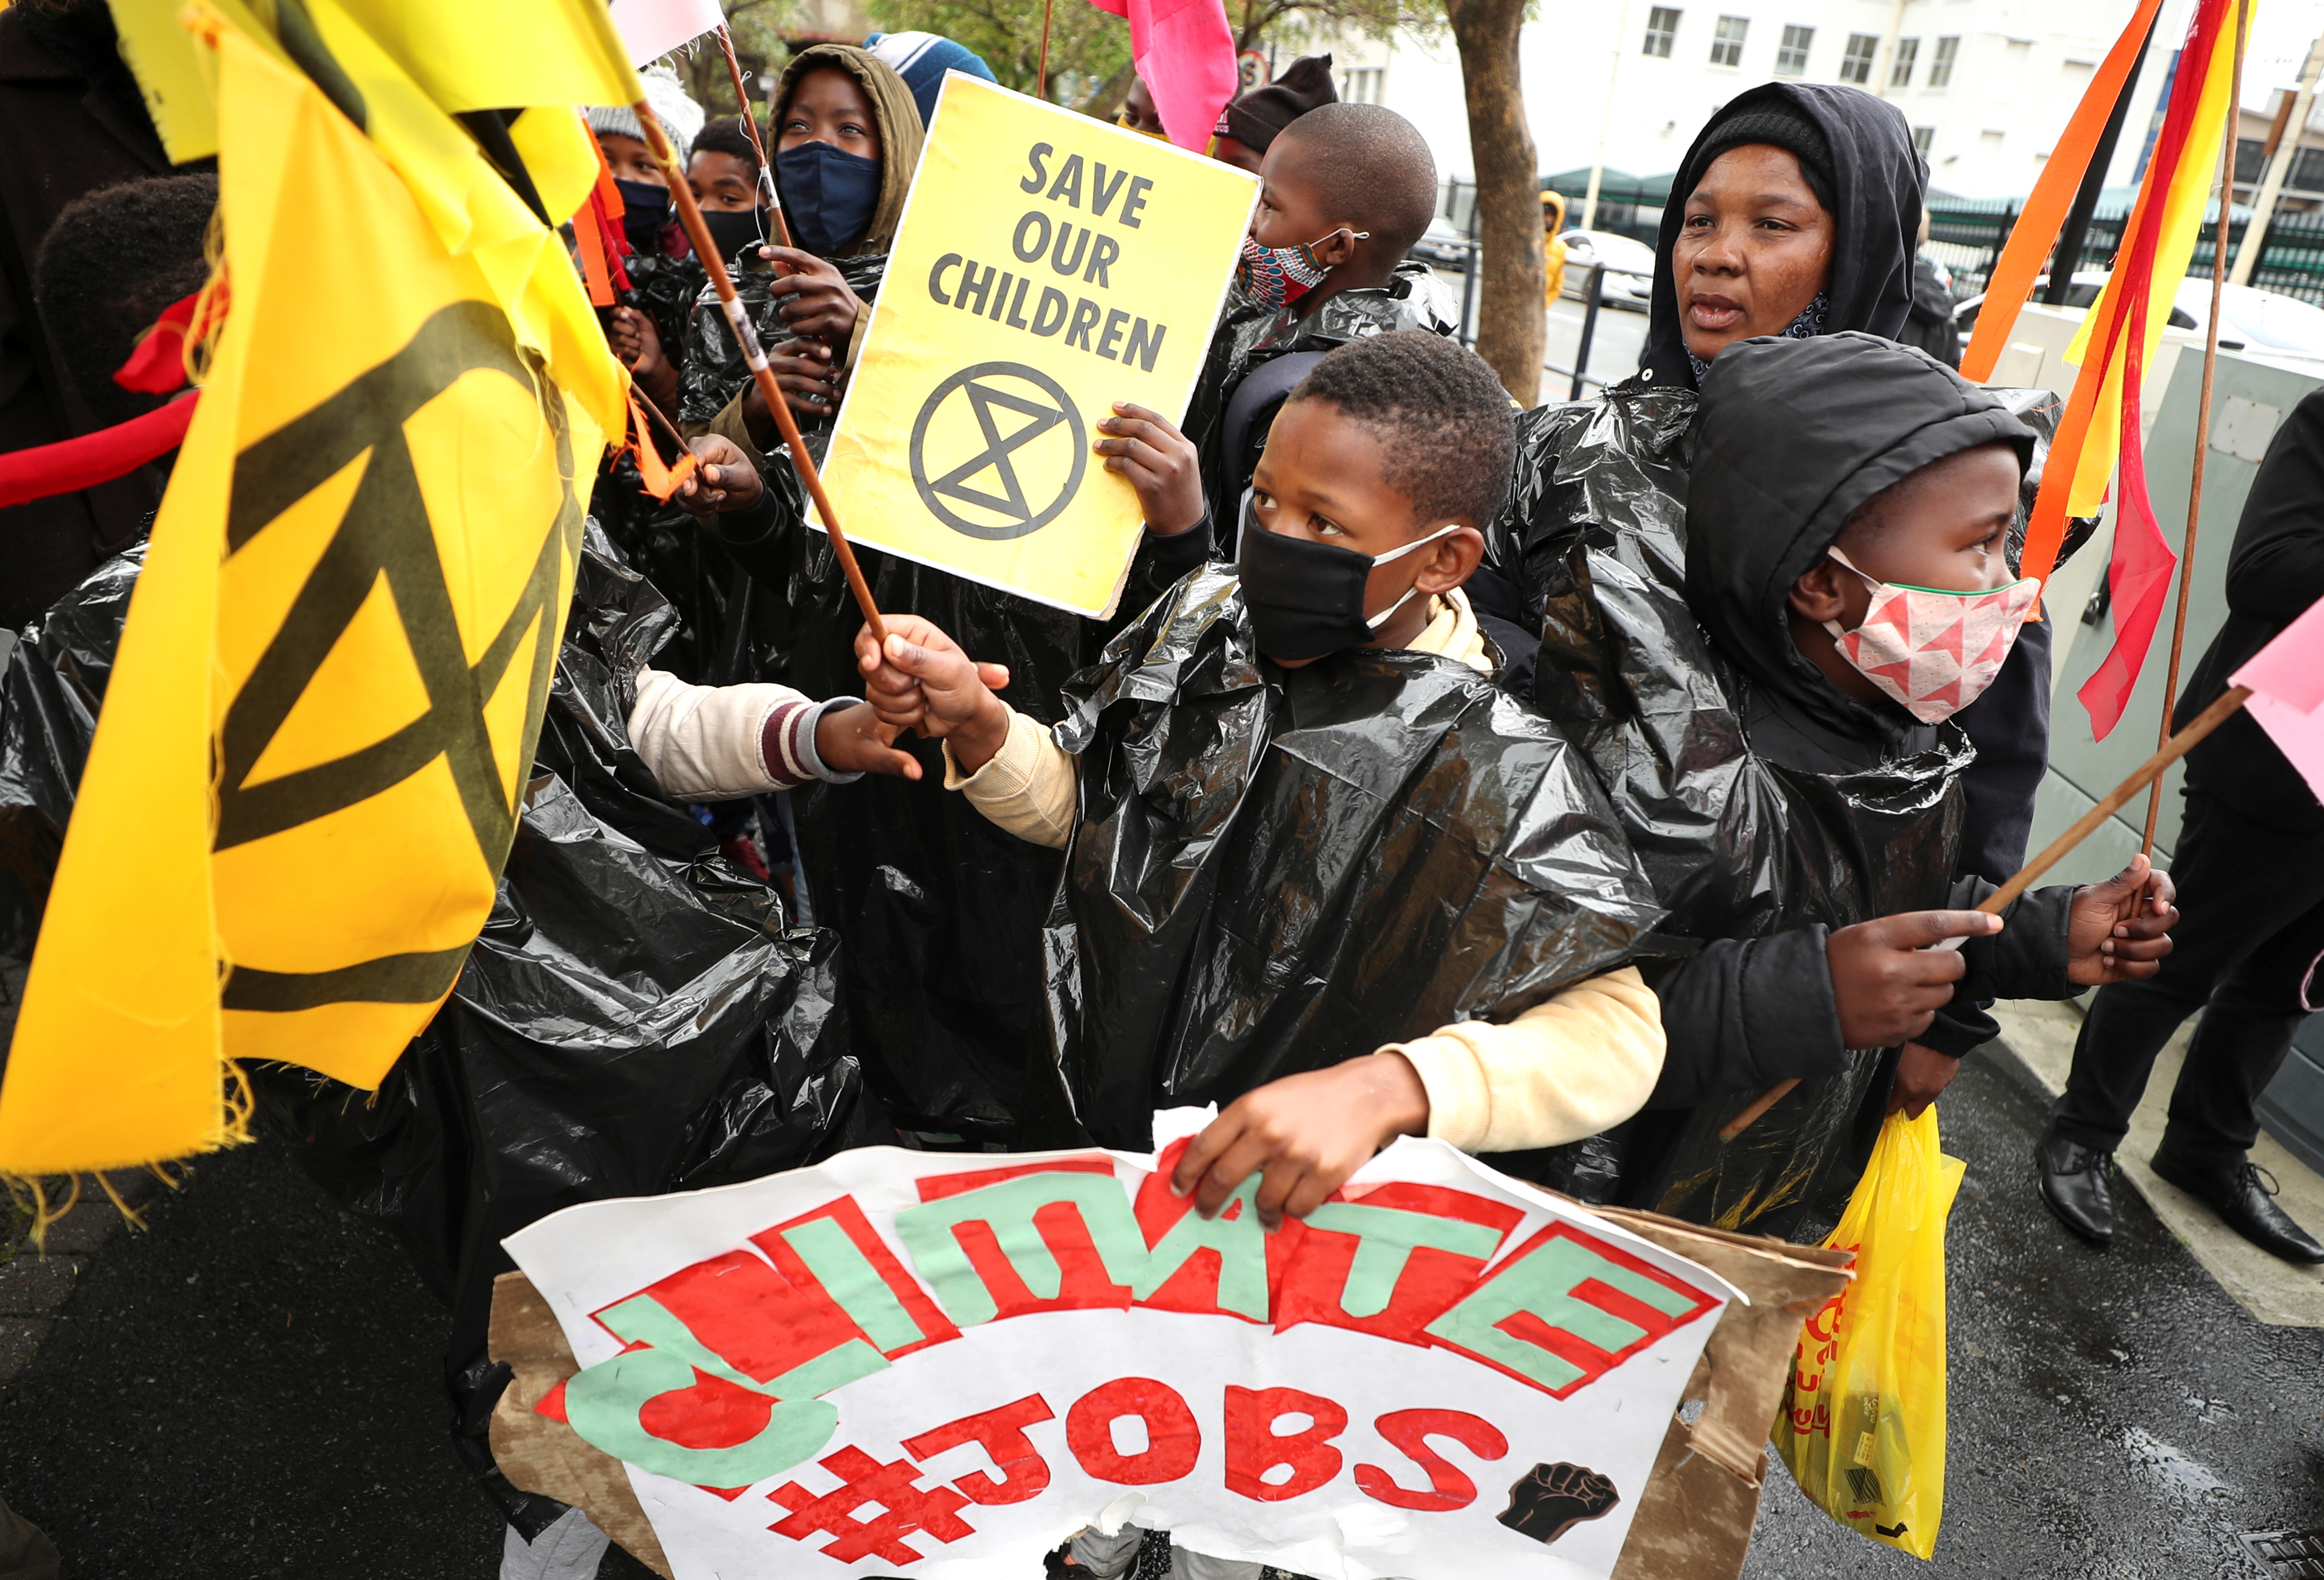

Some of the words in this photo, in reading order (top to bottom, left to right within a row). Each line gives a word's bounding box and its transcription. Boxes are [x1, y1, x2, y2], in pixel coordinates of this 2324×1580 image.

[1020, 142, 1153, 229] SAVE
[1012, 211, 1120, 288] OUR
[928, 253, 1167, 372] CHILDREN
[561, 1170, 1700, 1490] CLIMATE
[765, 1377, 1508, 1566] #JOBS
